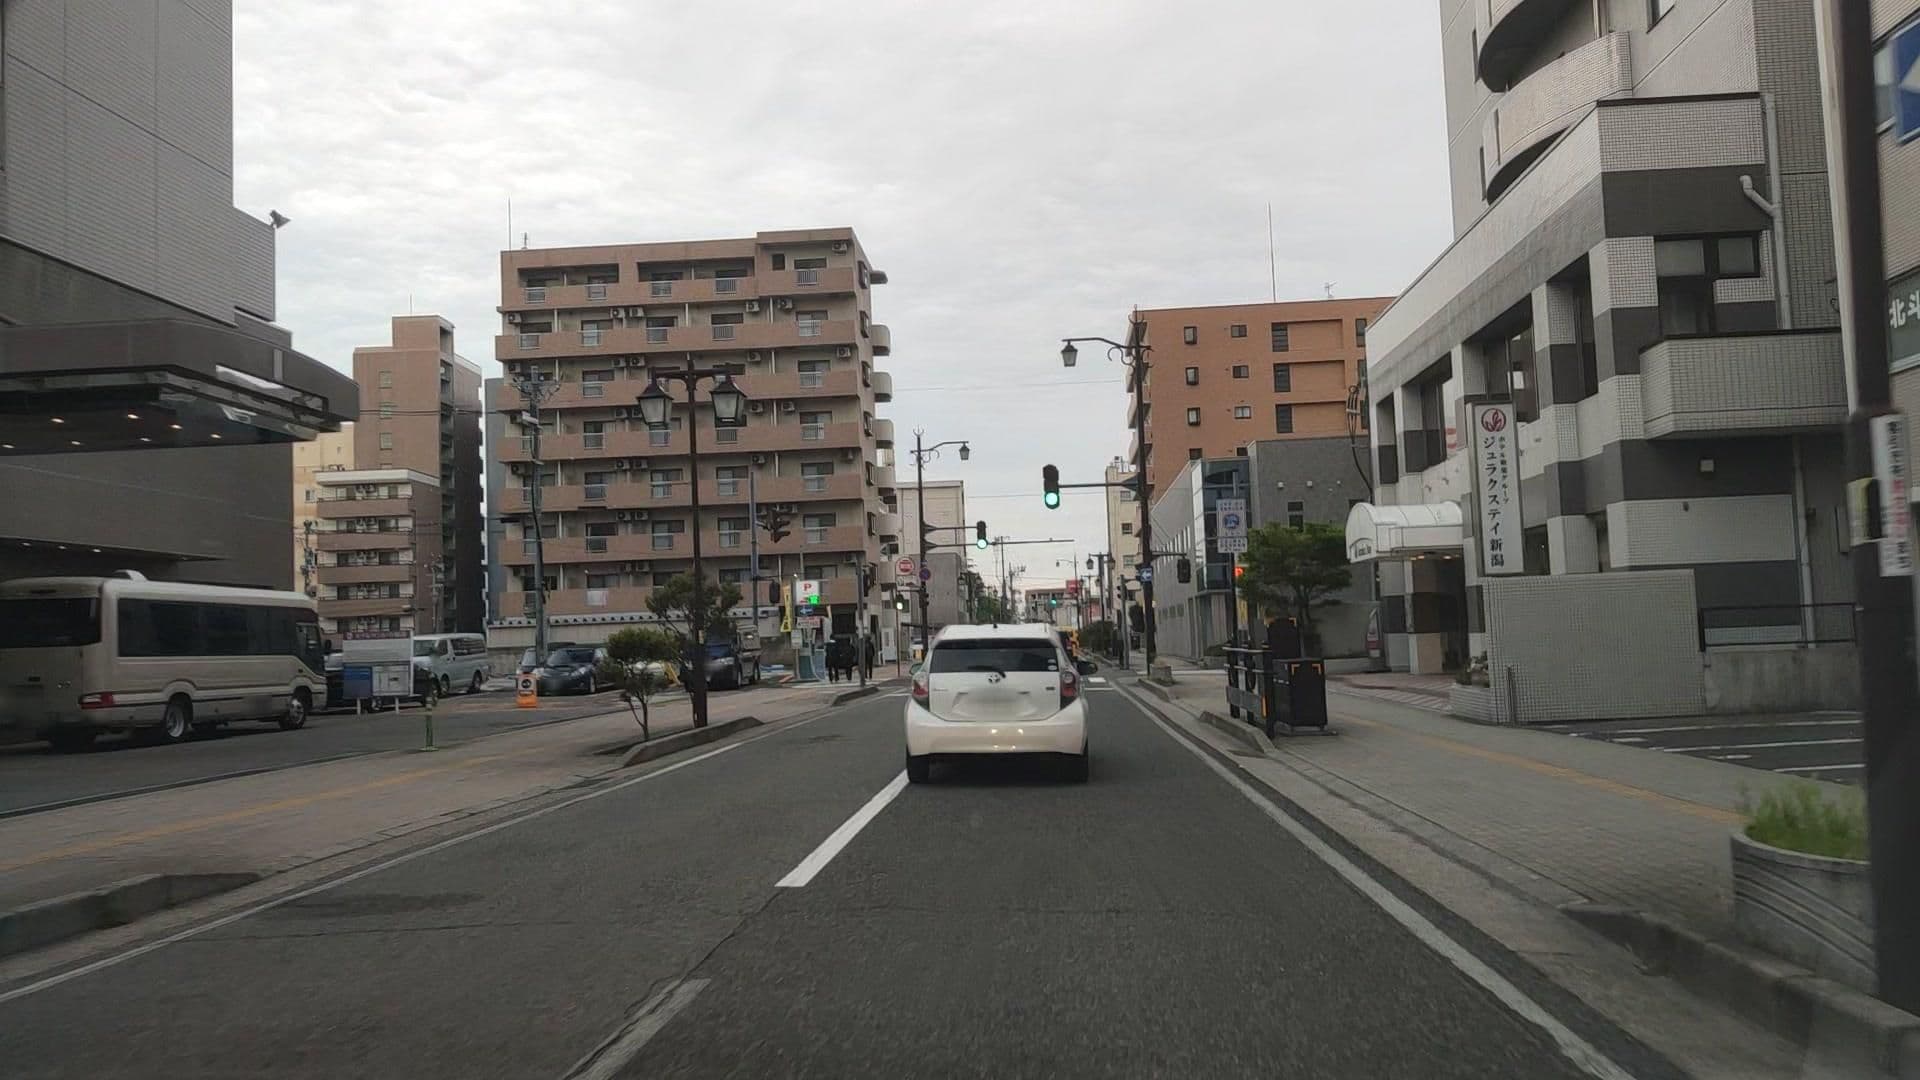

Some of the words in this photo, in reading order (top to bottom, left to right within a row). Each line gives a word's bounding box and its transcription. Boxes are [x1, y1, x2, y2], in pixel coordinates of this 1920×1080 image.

[1483, 436, 1504, 567] ジュラクステイ新潟
